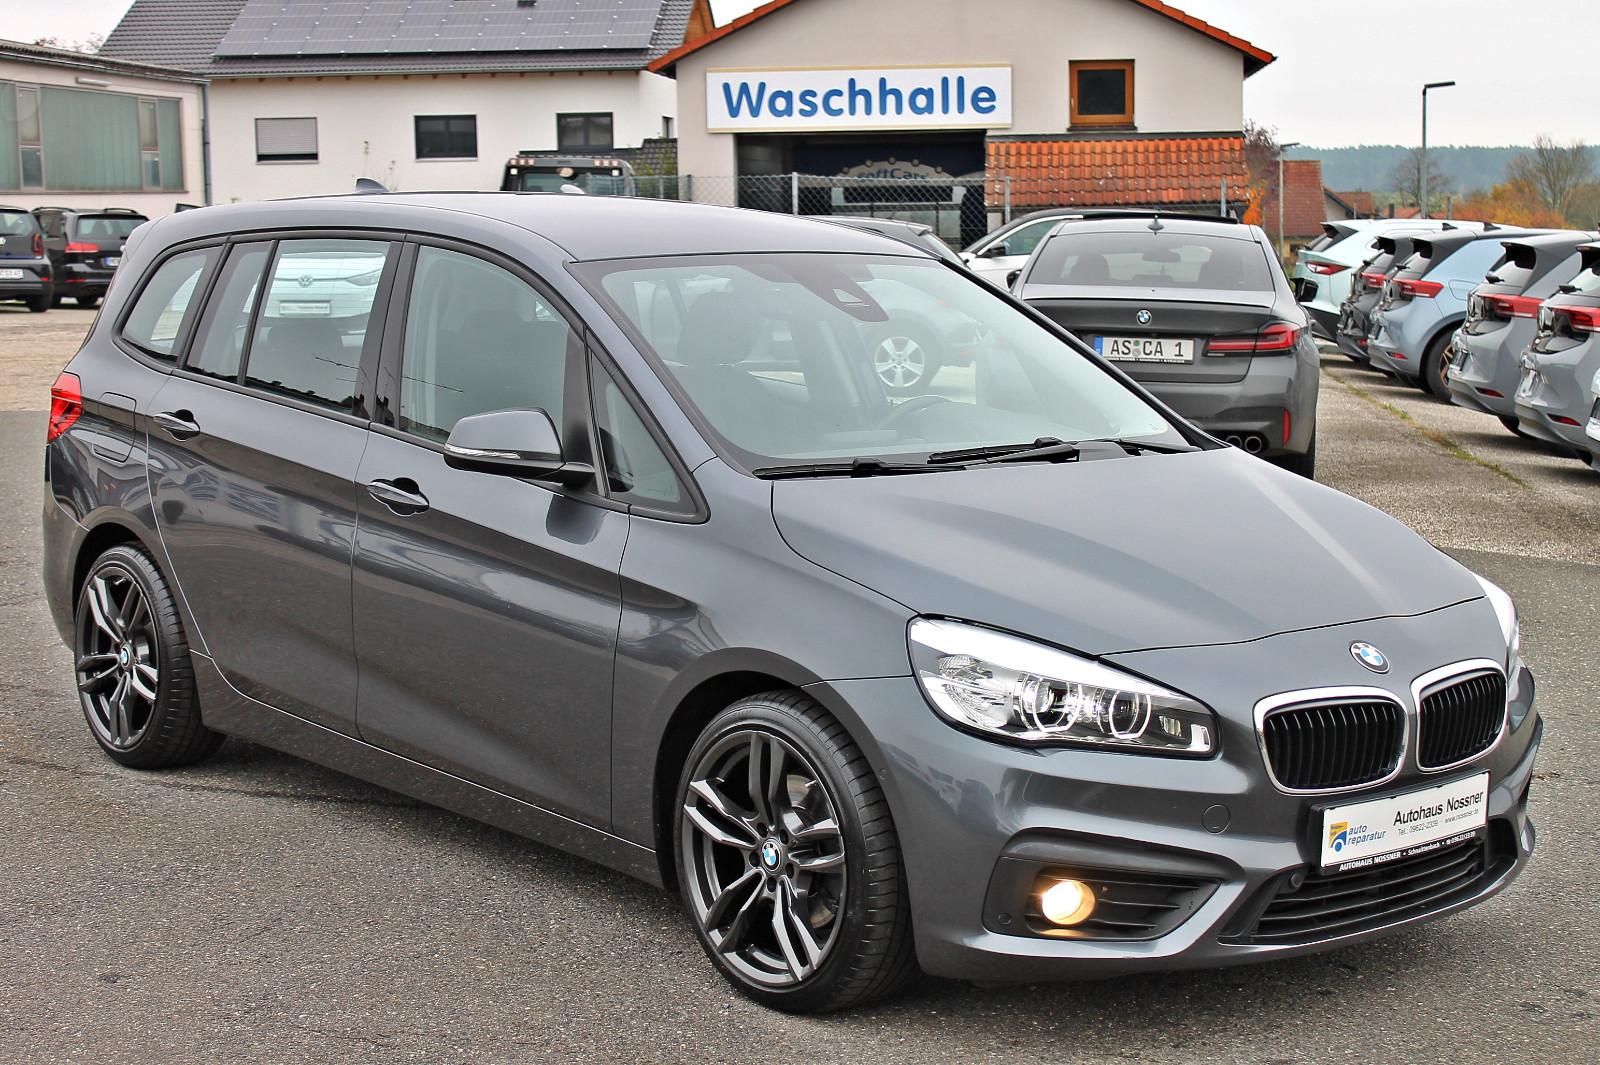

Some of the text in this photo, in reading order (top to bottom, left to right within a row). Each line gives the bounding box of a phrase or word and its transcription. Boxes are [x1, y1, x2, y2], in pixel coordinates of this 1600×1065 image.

[722, 76, 997, 118] Waschhalle
[1111, 340, 1184, 357] AS CA 1
[1393, 791, 1484, 826] Autohaus Nossner
[1347, 830, 1386, 846] reparatur
[1348, 823, 1368, 836] auto
[1339, 857, 1373, 872] AUTOHAUS
[1374, 851, 1401, 864] NOSSNER
